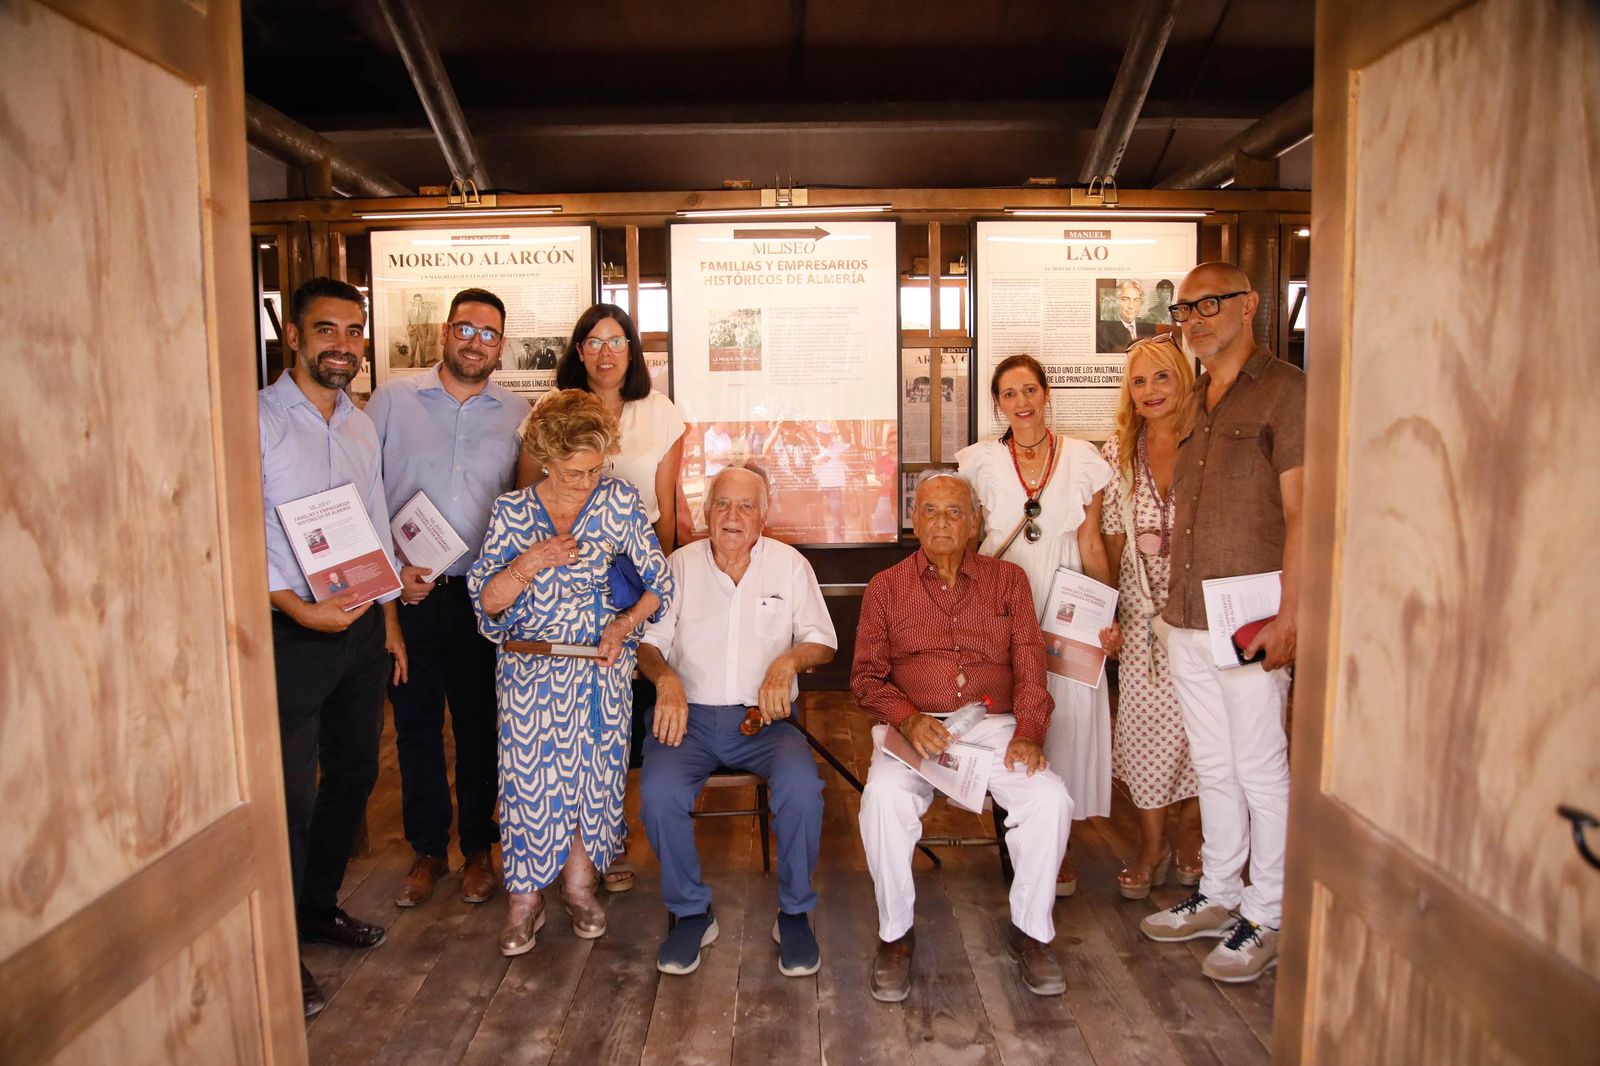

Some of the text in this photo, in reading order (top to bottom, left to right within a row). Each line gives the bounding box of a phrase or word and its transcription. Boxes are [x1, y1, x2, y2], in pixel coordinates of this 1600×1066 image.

[1069, 231, 1106, 239] MANUEL
[389, 246, 575, 268] MORENO ALARCÓN
[1066, 245, 1109, 261] LAO
[700, 259, 868, 272] FAMILIAS Y EMPRESARIOS
[703, 271, 865, 286] HISTÓRICOS DE ALMERÍA
[1047, 366, 1061, 374] SOLO
[1062, 366, 1073, 374] UNO
[1075, 366, 1082, 374] DE
[1082, 366, 1093, 374] LOS
[521, 380, 531, 388] SUS
[532, 379, 550, 387] LÍNEAS
[1047, 375, 1054, 383] DE
[1055, 375, 1065, 383] LOS
[1066, 375, 1101, 383] PRINCIPALES
